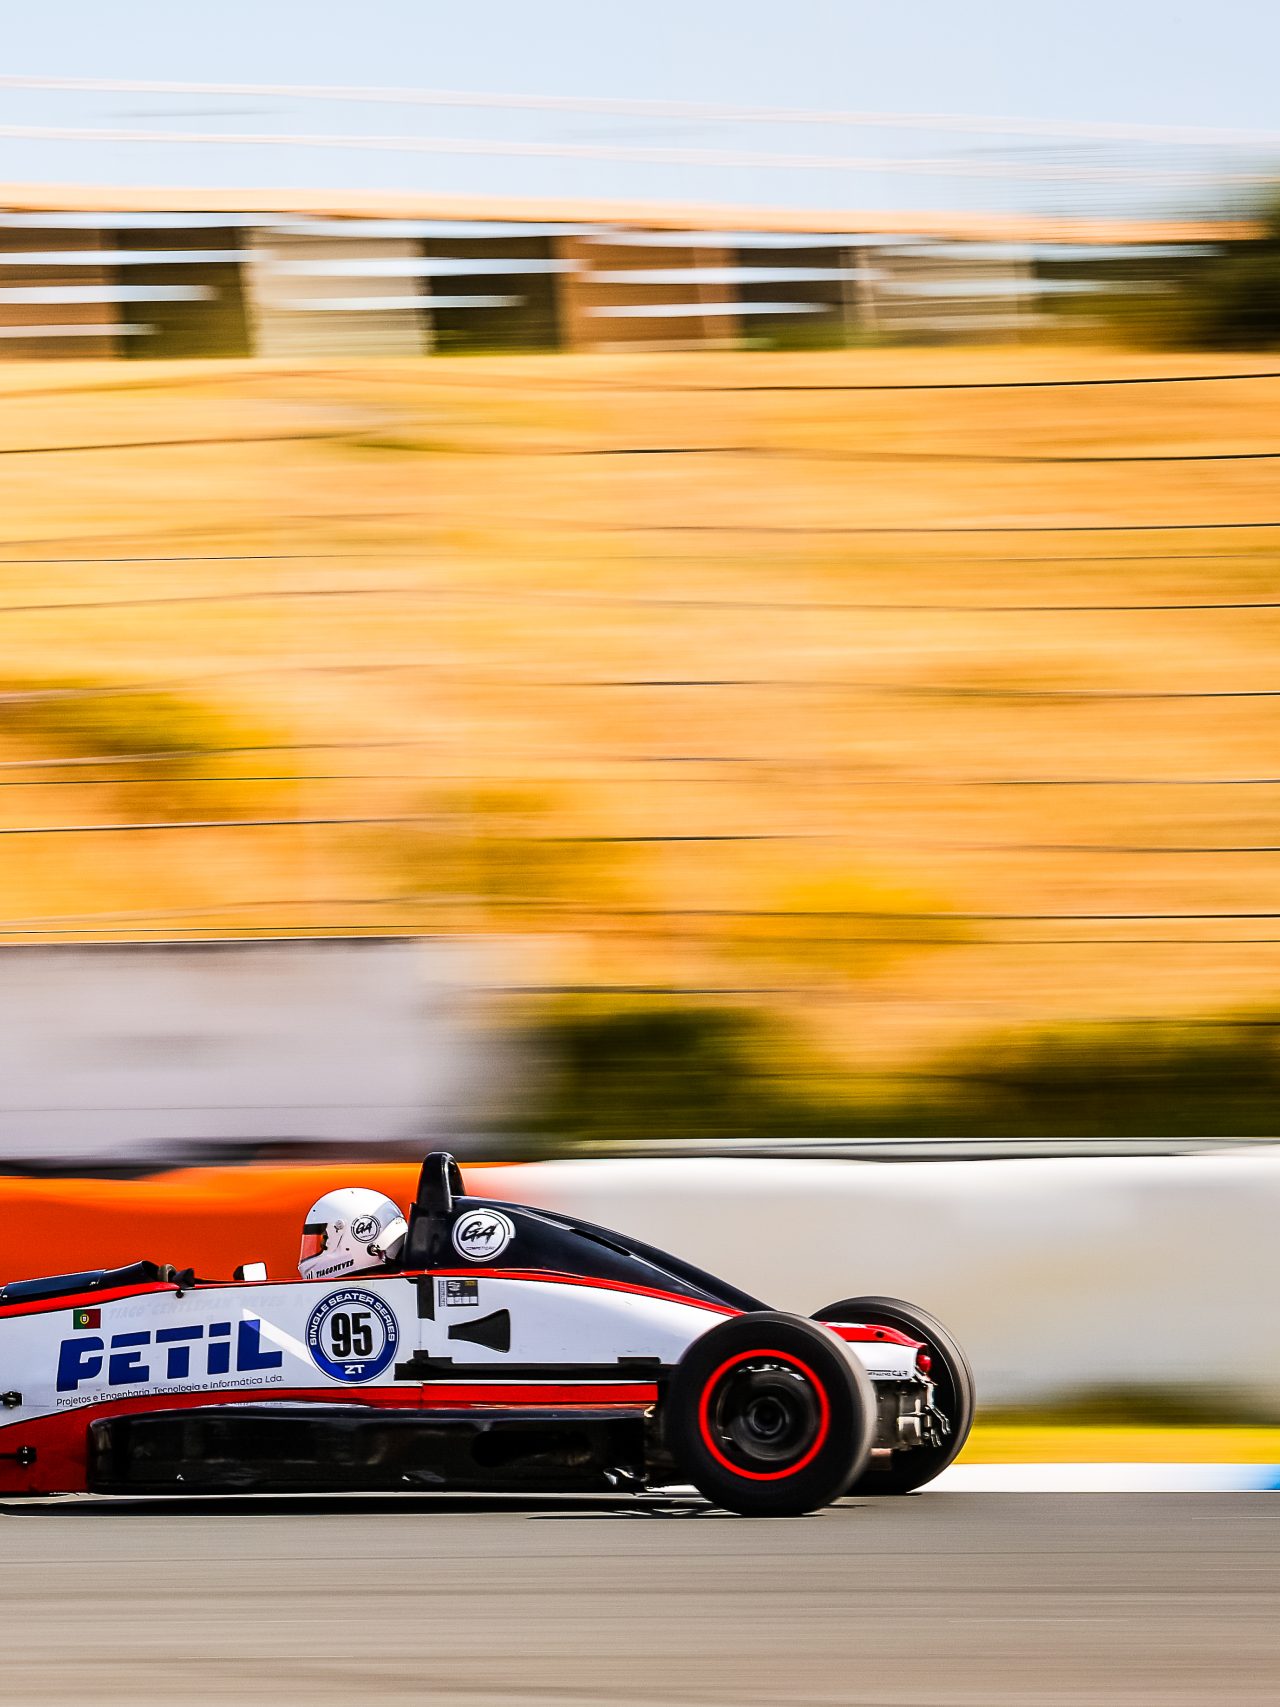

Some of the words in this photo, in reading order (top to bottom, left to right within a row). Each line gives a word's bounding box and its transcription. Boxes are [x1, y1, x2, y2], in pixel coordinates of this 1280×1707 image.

[309, 1303, 330, 1346] SINGLE
[328, 1292, 375, 1307] SEATER
[373, 1301, 396, 1342] SERIES
[330, 1311, 374, 1358] 95
[344, 1364, 366, 1375] ZT
[56, 1396, 92, 1407] Projetos
[210, 1377, 263, 1389] Informática
